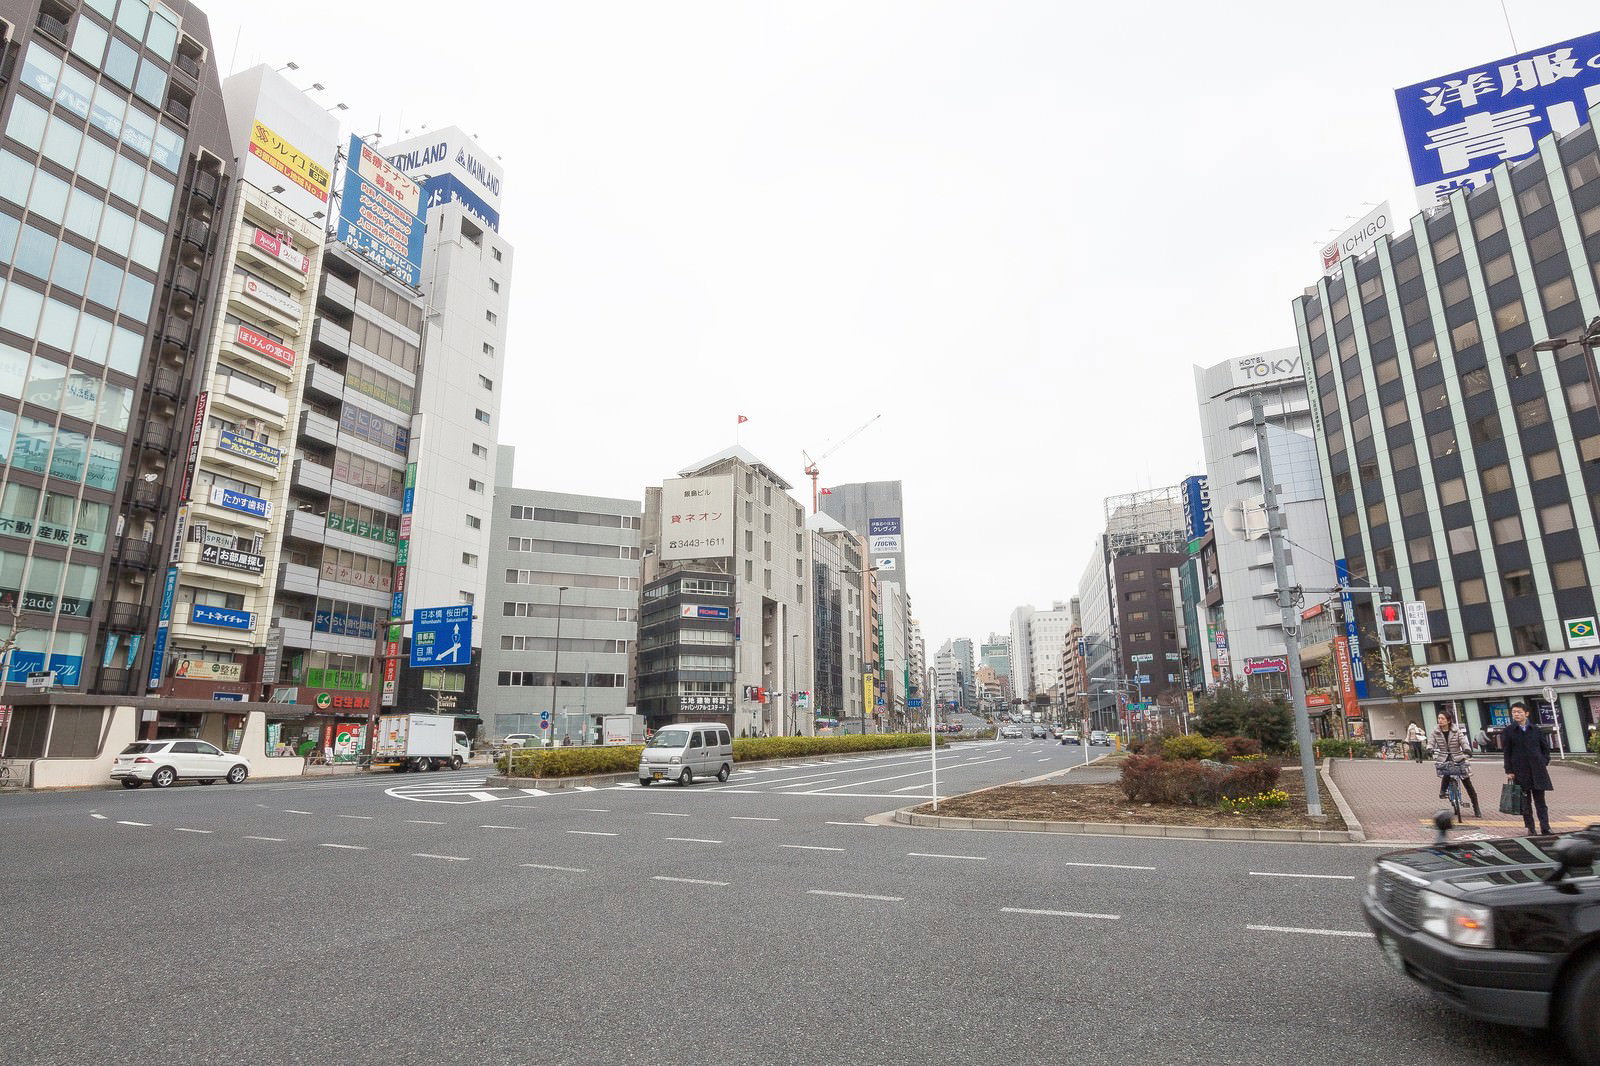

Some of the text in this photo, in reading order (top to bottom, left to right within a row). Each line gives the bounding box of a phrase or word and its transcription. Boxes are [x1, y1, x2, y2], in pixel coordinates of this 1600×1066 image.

[272, 137, 306, 172] ソレイユ
[361, 147, 419, 197] 医療テナント
[466, 153, 500, 197] MAINLAND
[375, 174, 405, 201] 募集中
[1341, 214, 1387, 255] ICHIGO
[239, 331, 291, 360] ほけんの窓口
[1239, 356, 1266, 366] HOTEL
[223, 493, 265, 513] たかす歯科
[1181, 482, 1194, 537] サロンパス
[0, 517, 89, 546] 不動産販売
[206, 534, 233, 547] SPRIN
[203, 546, 217, 557] 4F
[677, 538, 726, 548] 3443-1611
[219, 549, 264, 568] お部屋探し
[195, 609, 249, 624] アートネイチャー
[421, 607, 469, 619] 日本橋 桜田門
[416, 647, 434, 656] 目黒
[1337, 641, 1346, 660] First
[12, 661, 77, 676] リバブル
[220, 664, 239, 676] 整体
[386, 642, 397, 681] 処方ん受付
